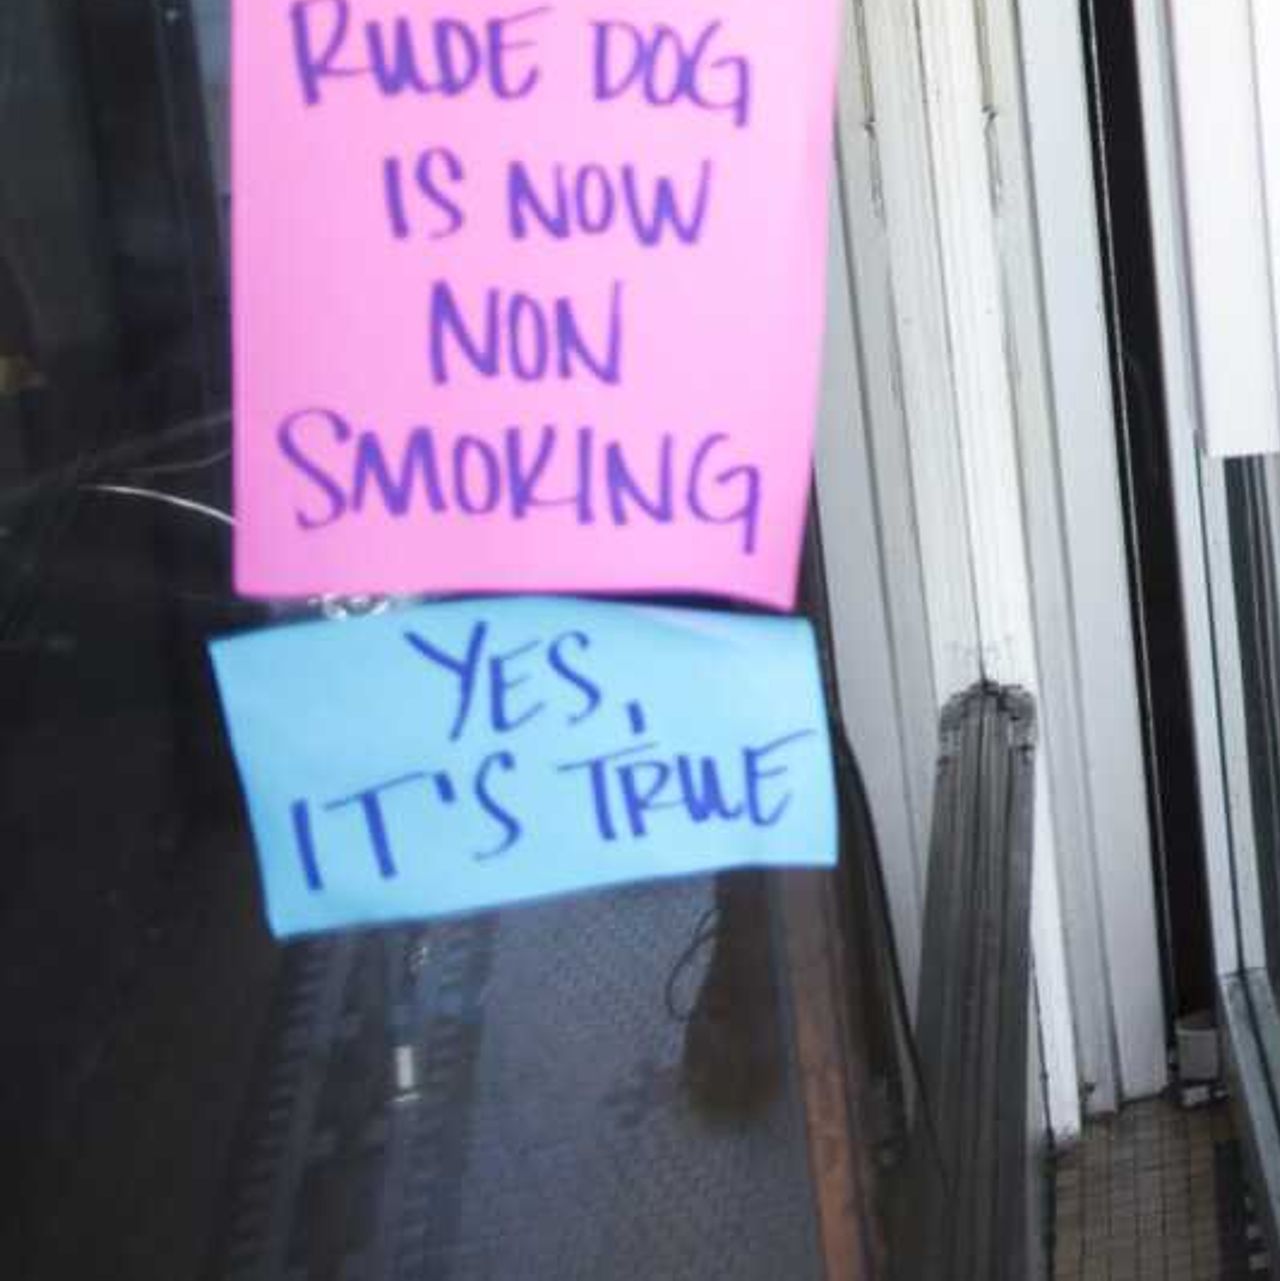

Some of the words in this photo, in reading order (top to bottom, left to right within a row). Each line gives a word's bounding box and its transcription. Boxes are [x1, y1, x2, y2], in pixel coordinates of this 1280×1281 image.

[590, 19, 752, 129] DOG
[384, 146, 467, 240] IS
[506, 159, 713, 247] NOW
[428, 279, 624, 386] NON
[277, 408, 763, 555] SMOKING
[405, 620, 648, 743] YES,
[290, 750, 524, 891] IT'S
[558, 728, 819, 841] TRUE
